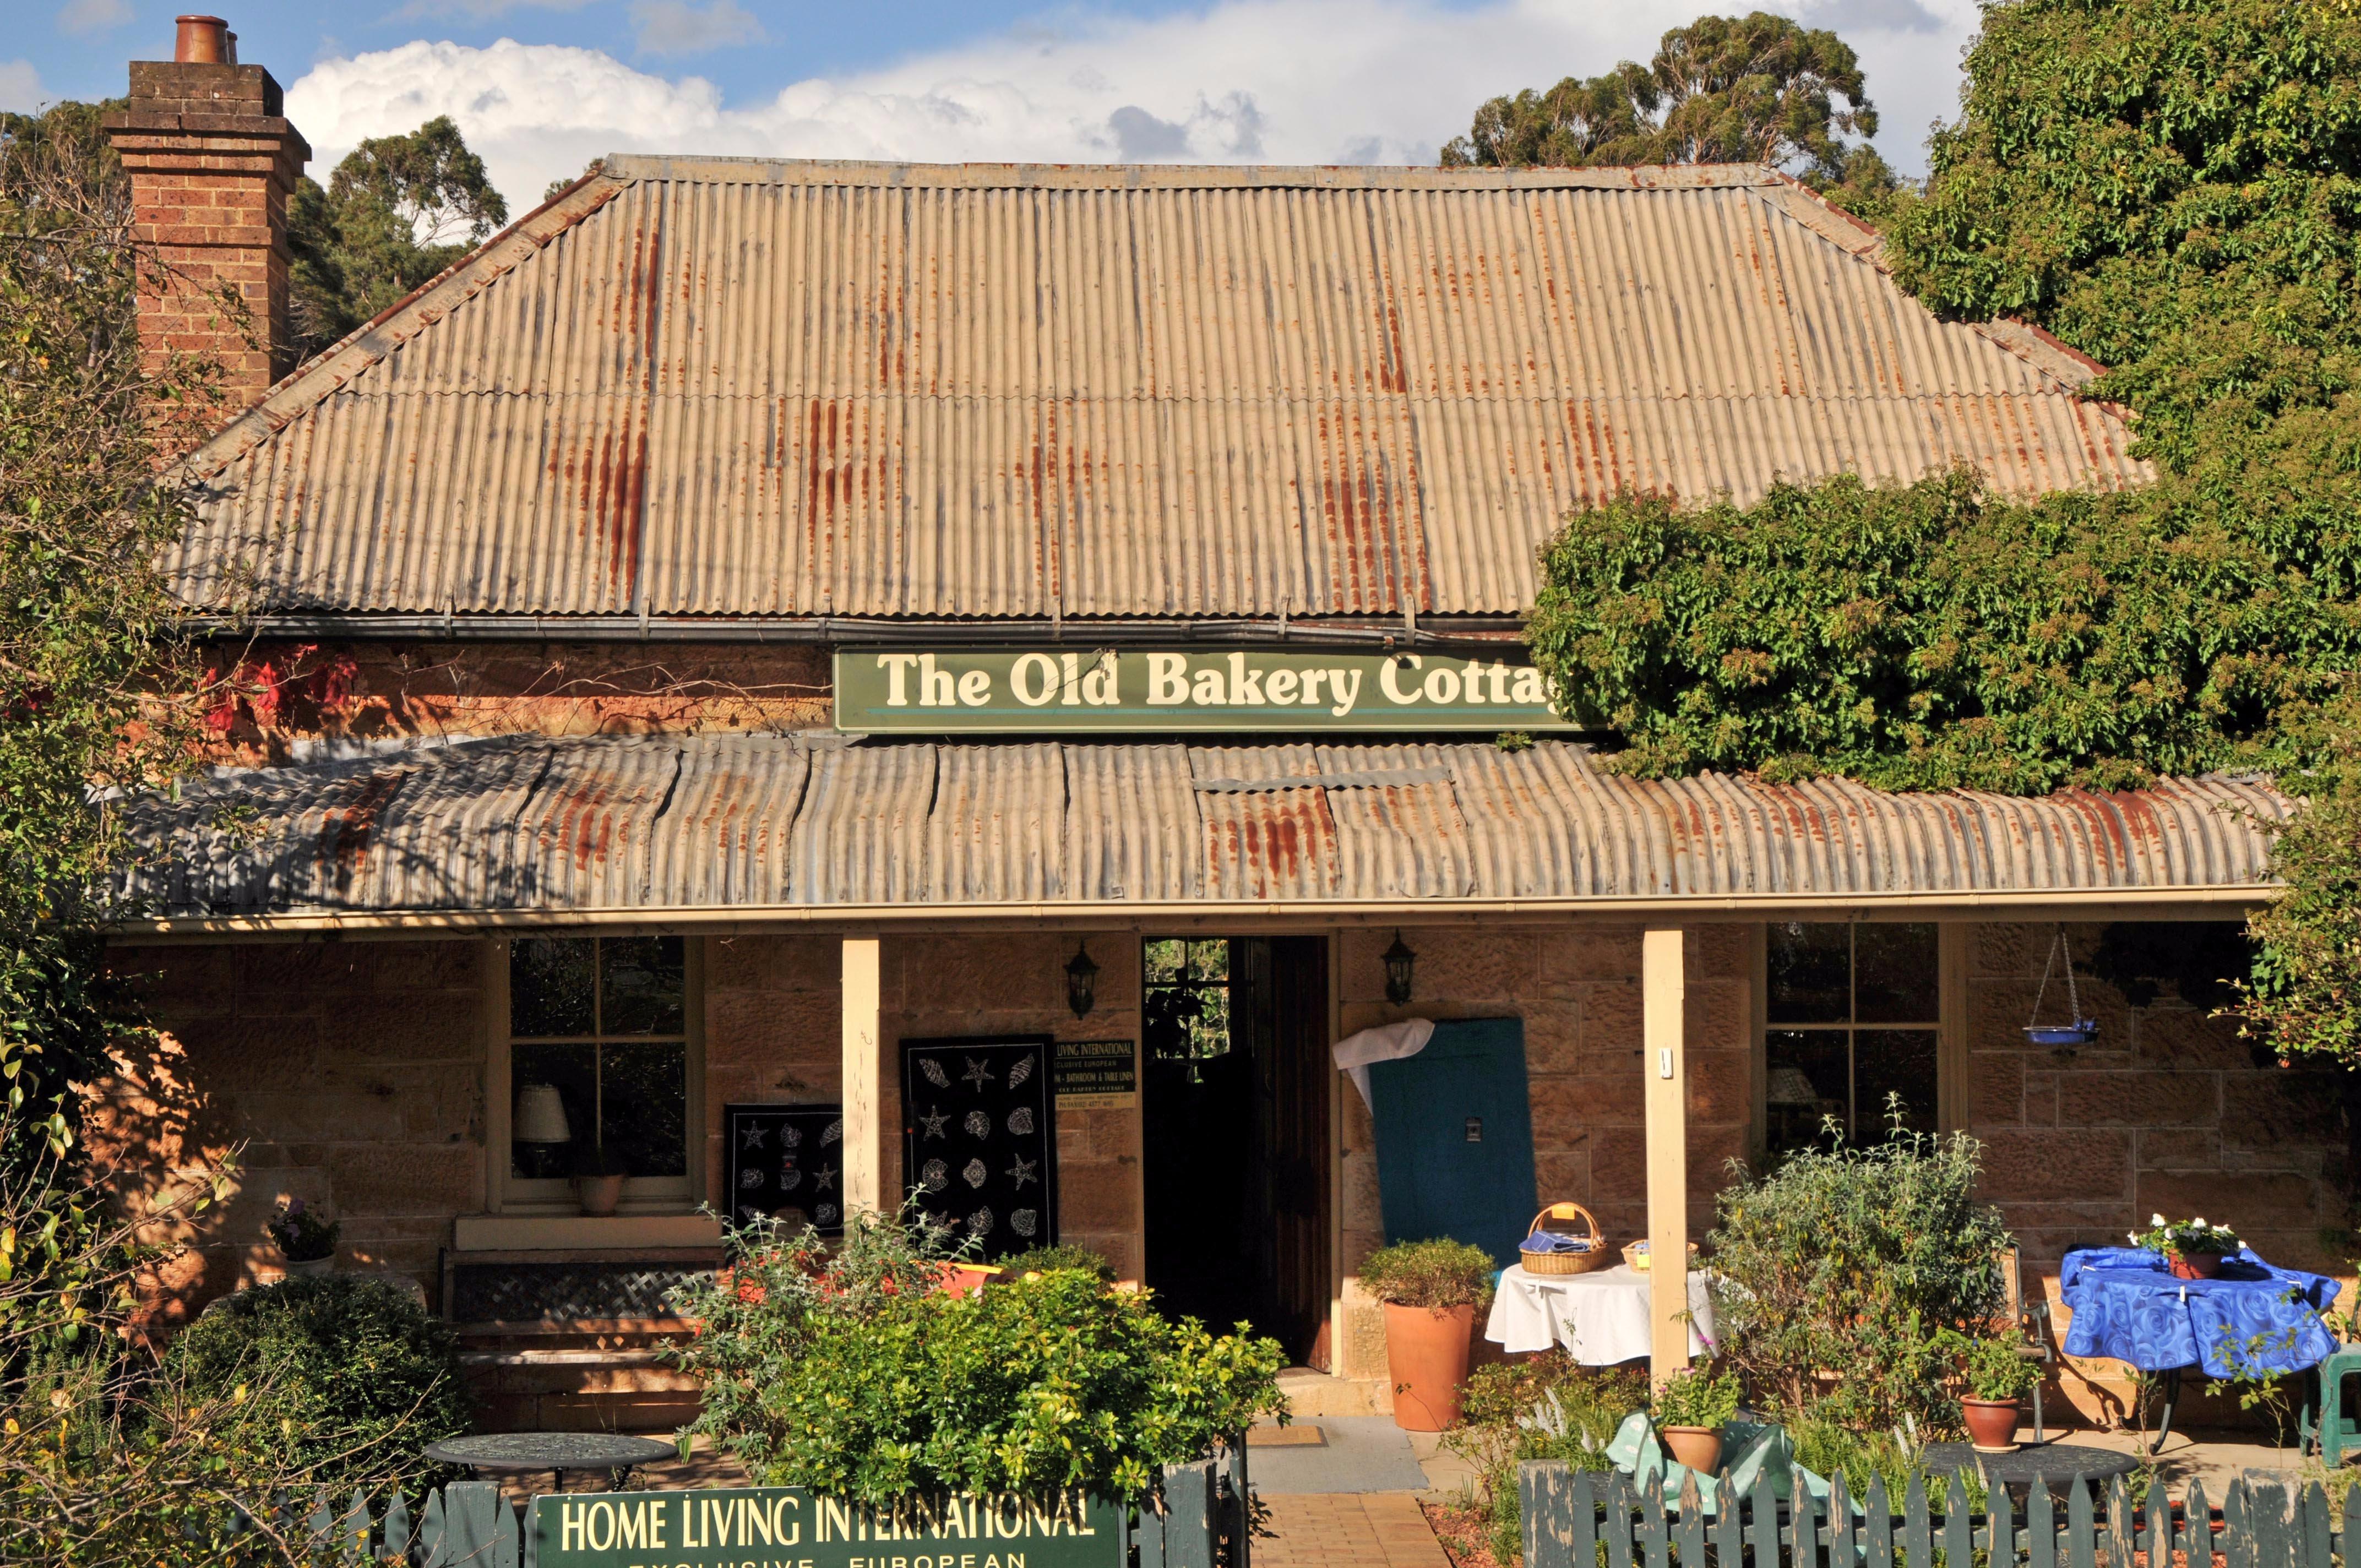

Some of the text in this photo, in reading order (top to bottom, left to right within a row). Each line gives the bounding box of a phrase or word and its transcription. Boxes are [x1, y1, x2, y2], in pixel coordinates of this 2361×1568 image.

[877, 651, 1570, 717] The Old Bakery Cotta
[1057, 1042, 1131, 1056] LIVING INTERNATIONAL
[1067, 1072, 1096, 1082] BATHROOM
[1105, 1072, 1118, 1081] TABLE
[1119, 1071, 1133, 1081] LINEN
[562, 1488, 1095, 1551] HOME LIVING INTERNATIONAL
